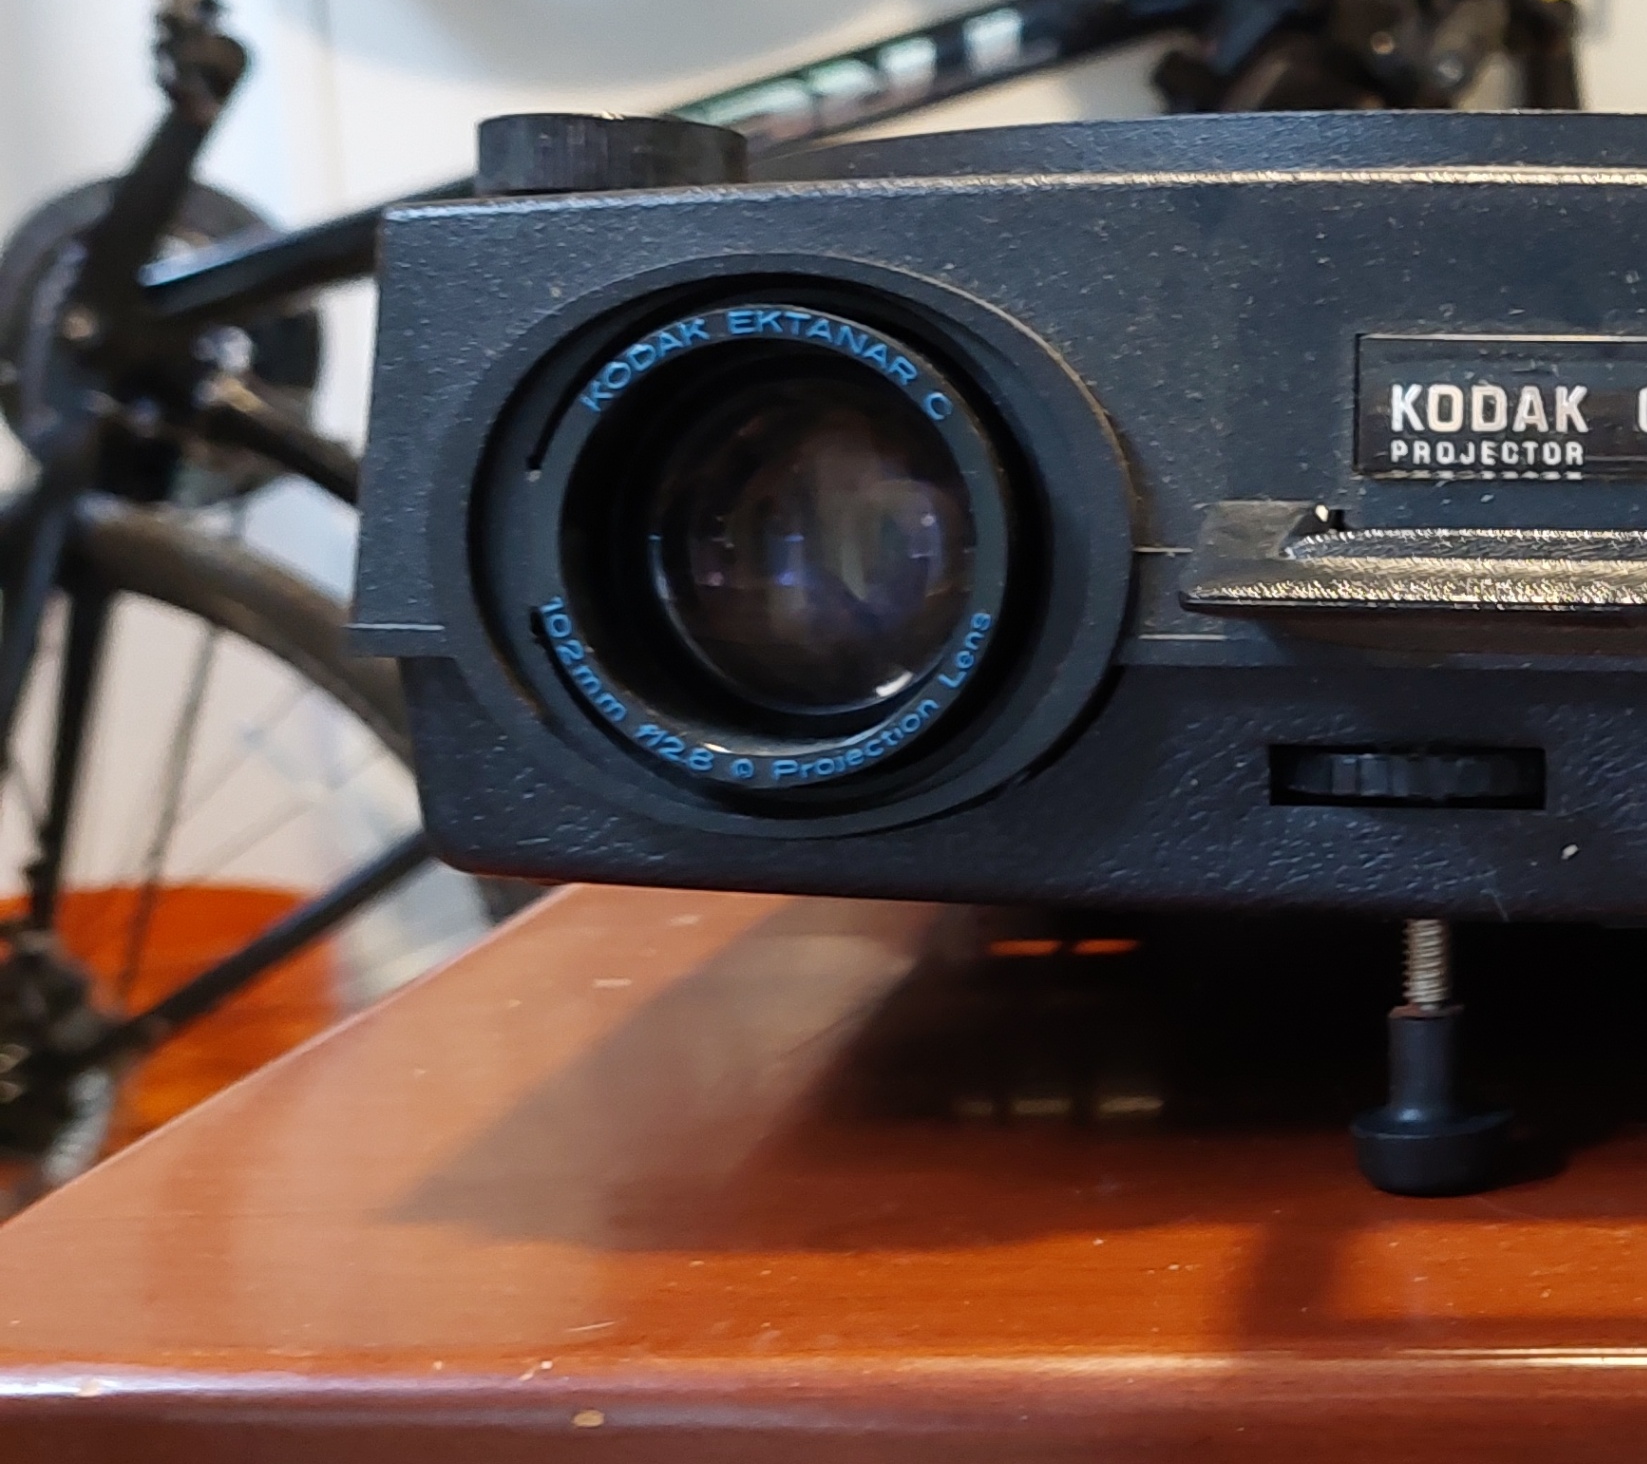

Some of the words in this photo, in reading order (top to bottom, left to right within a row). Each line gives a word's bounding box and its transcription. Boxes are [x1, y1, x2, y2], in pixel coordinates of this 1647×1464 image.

[579, 317, 711, 413] KODAK
[726, 308, 919, 387] EKTANAR
[922, 390, 955, 422] C
[1389, 383, 1590, 434] KODAK
[1390, 441, 1585, 466] PROJECTOR
[538, 596, 628, 723] 102mm
[771, 699, 940, 781] Projection
[937, 611, 993, 690] Lens
